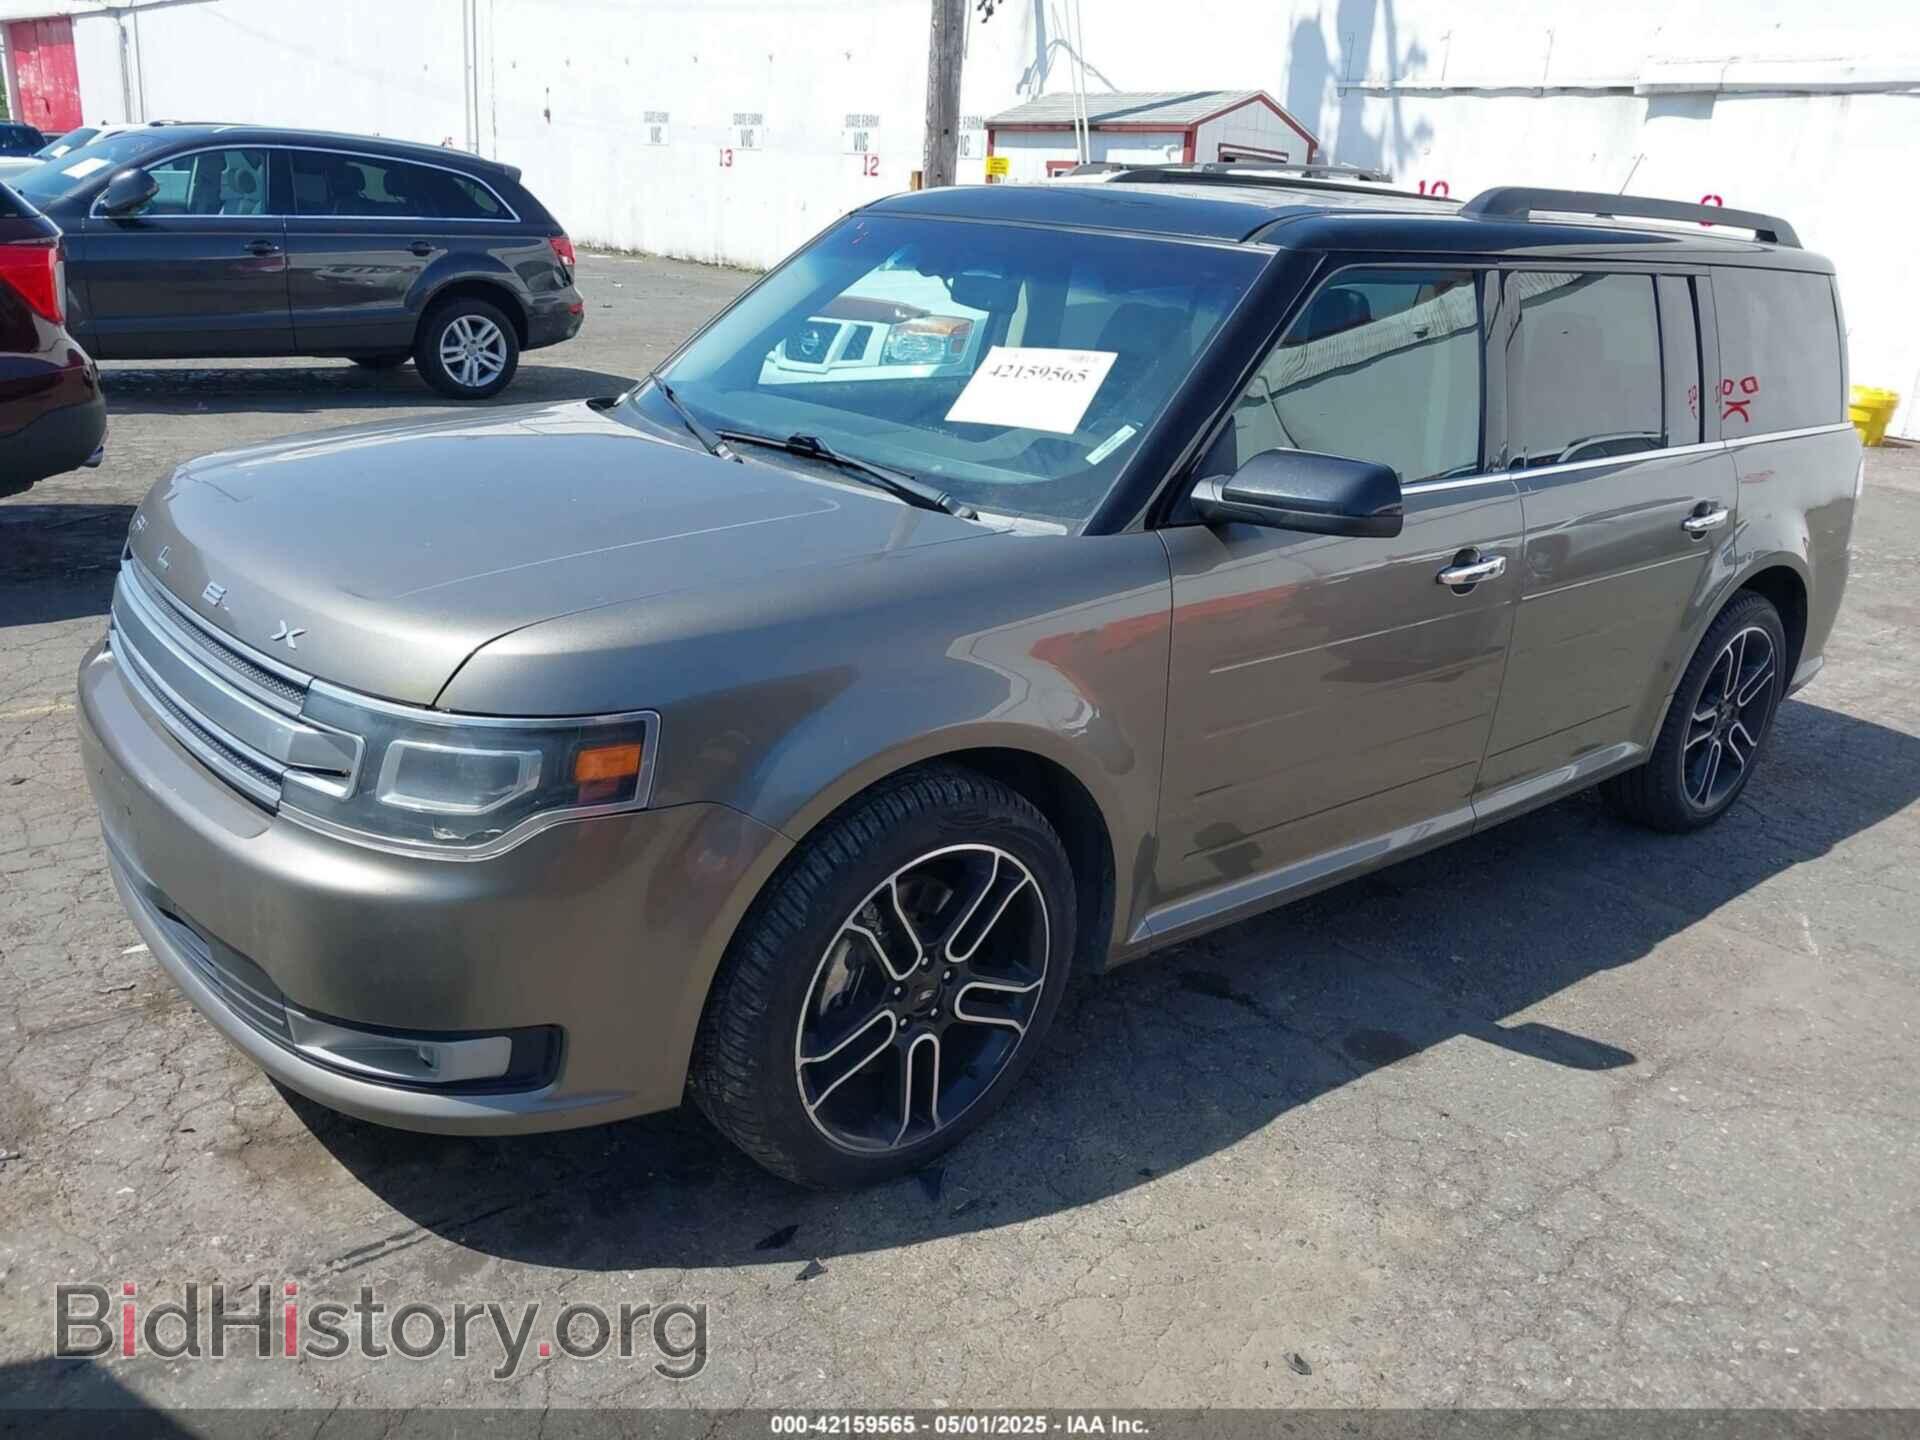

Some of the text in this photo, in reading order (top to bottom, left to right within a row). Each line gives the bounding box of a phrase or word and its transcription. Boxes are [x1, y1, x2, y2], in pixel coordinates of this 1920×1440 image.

[853, 131, 869, 152] VIC
[719, 148, 733, 168] 13
[864, 154, 880, 177] 12
[988, 364, 1091, 384] 42159565
